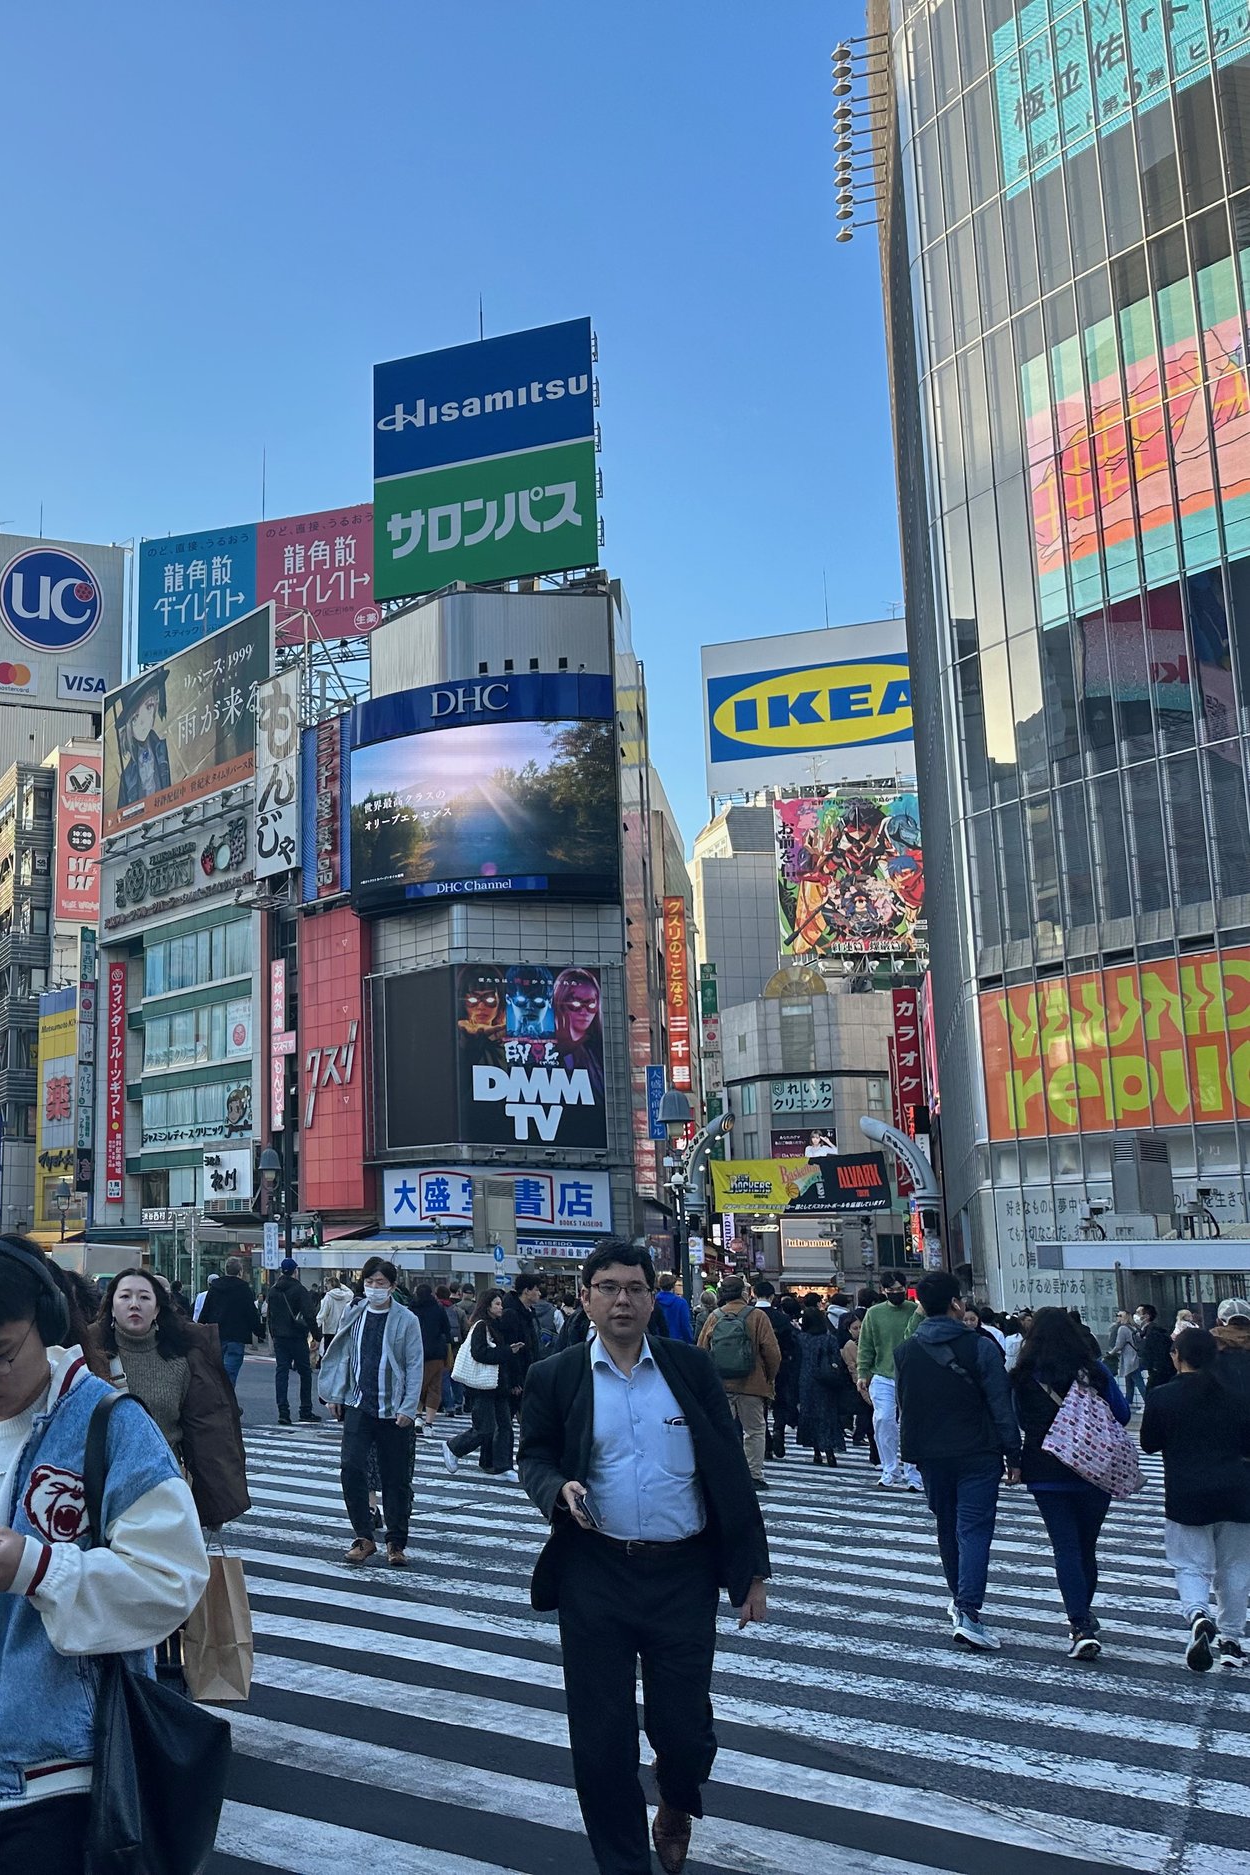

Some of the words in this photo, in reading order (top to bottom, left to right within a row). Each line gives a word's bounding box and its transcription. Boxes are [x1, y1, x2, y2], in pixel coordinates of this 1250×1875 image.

[377, 373, 588, 432] Hisamitsu
[387, 481, 582, 560] サロンパス
[147, 532, 250, 558] のど、直接、うるおう
[283, 534, 358, 576] 龍角散
[163, 554, 233, 593] 龍角散
[272, 569, 372, 609] ダイレクト
[11, 572, 92, 625] UC
[153, 588, 246, 626] ダイレクト
[355, 612, 380, 625] 生薬
[61, 673, 107, 694] VISA
[430, 684, 509, 718] DHC
[177, 680, 261, 749] 雨が来る
[734, 679, 912, 732] IKEA
[257, 680, 296, 866] もんじゃ
[364, 790, 447, 814] 世界最高クラスの
[67, 856, 96, 873] B1F
[67, 874, 95, 891] B2F
[436, 882, 463, 894] DHC
[464, 878, 512, 892] Channel
[667, 901, 683, 1007] クスリのことなら
[670, 1016, 690, 1083] 三千里
[896, 1001, 921, 1092] カラオケ
[303, 1019, 359, 1128] クスリ
[473, 1064, 596, 1106] DMM
[787, 1081, 832, 1095] れいわ
[46, 1075, 72, 1121] 薬
[773, 1096, 832, 1111] クリニック
[142, 1124, 224, 1143] ジャスミンレディースクリニック
[505, 1103, 564, 1141] TV
[729, 1175, 773, 1194] ROCKERS
[836, 1163, 883, 1189] ALVARK
[559, 1219, 577, 1227] BOOKS
[578, 1219, 604, 1228] TAISEIDO
